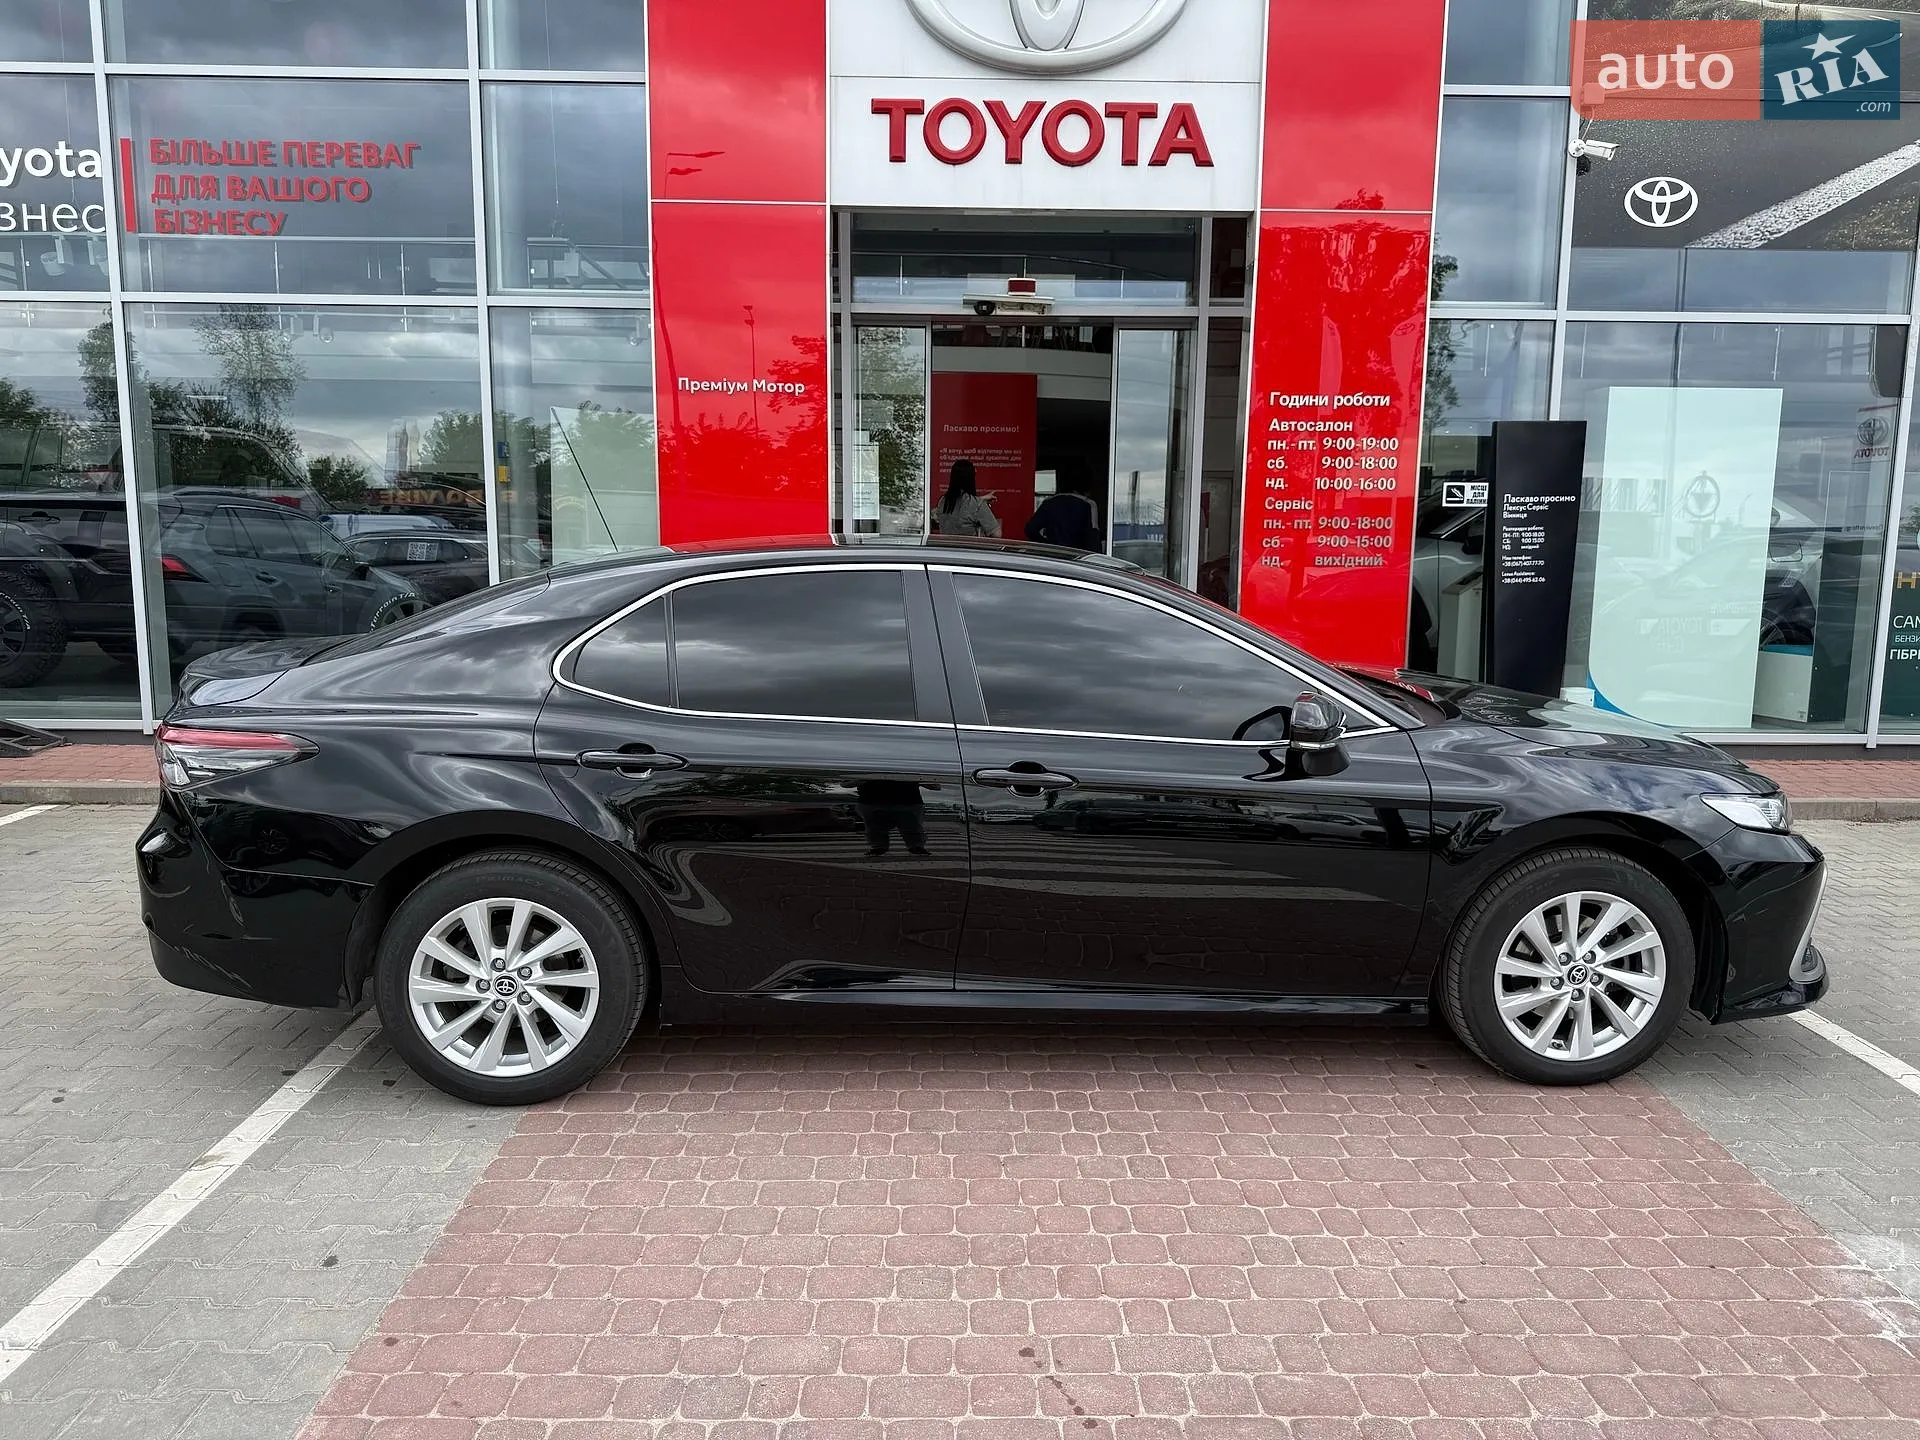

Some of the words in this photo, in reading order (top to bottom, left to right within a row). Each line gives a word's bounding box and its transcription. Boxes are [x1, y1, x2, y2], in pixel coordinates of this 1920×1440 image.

[871, 97, 1215, 168] TOYOTA
[150, 138, 272, 167] БІЛЬШЕ
[283, 141, 420, 168] ПЕРЕВАГ
[0, 141, 102, 187] yota
[152, 174, 217, 203] ДЛЯ
[226, 176, 370, 202] ВАШОГО
[154, 209, 284, 236] БІЗНЕСУ
[678, 377, 748, 395] Преміум
[753, 379, 805, 396] Мотор
[1269, 391, 1329, 408] Години
[1333, 392, 1390, 409] роботи
[980, 425, 1019, 434] просимо!
[1269, 418, 1353, 432] Автосалон
[1322, 437, 1399, 451] 9:00-19:00
[1266, 456, 1288, 469] сб.
[1321, 456, 1398, 470] 9:00-18:00
[1265, 478, 1289, 491] нд.
[1315, 477, 1396, 491] 10:00-16:00
[1264, 497, 1313, 512] Сервіс
[1540, 495, 1576, 504] просимо
[1318, 517, 1393, 530] 9:00-18:00
[1263, 536, 1284, 548] сб.
[1261, 556, 1284, 568] нд.
[1315, 554, 1383, 567] вихідний
